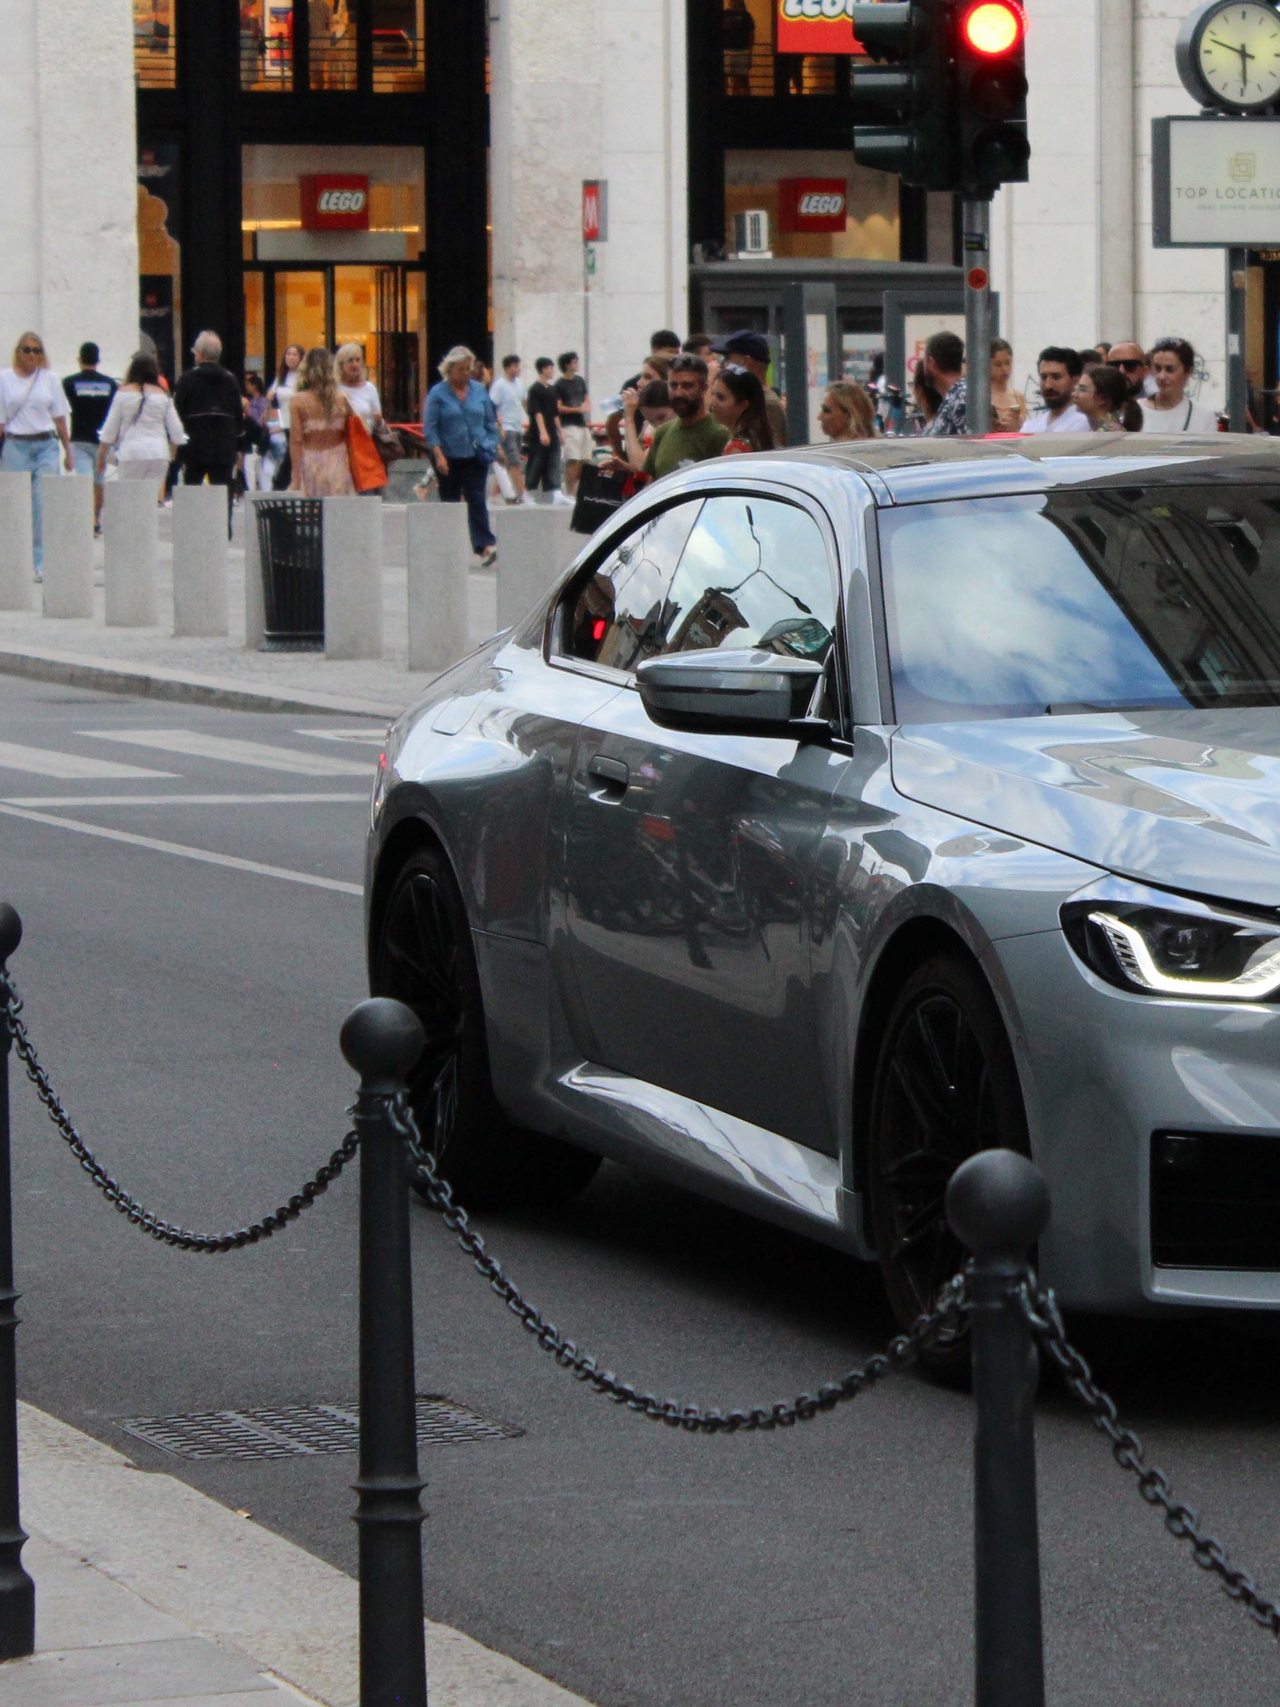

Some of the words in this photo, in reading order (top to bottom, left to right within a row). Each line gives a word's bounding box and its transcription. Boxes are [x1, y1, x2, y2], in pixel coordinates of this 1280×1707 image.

[319, 190, 365, 212] LEGO
[1175, 187, 1207, 199] TOP
[800, 194, 843, 215] LEGO
